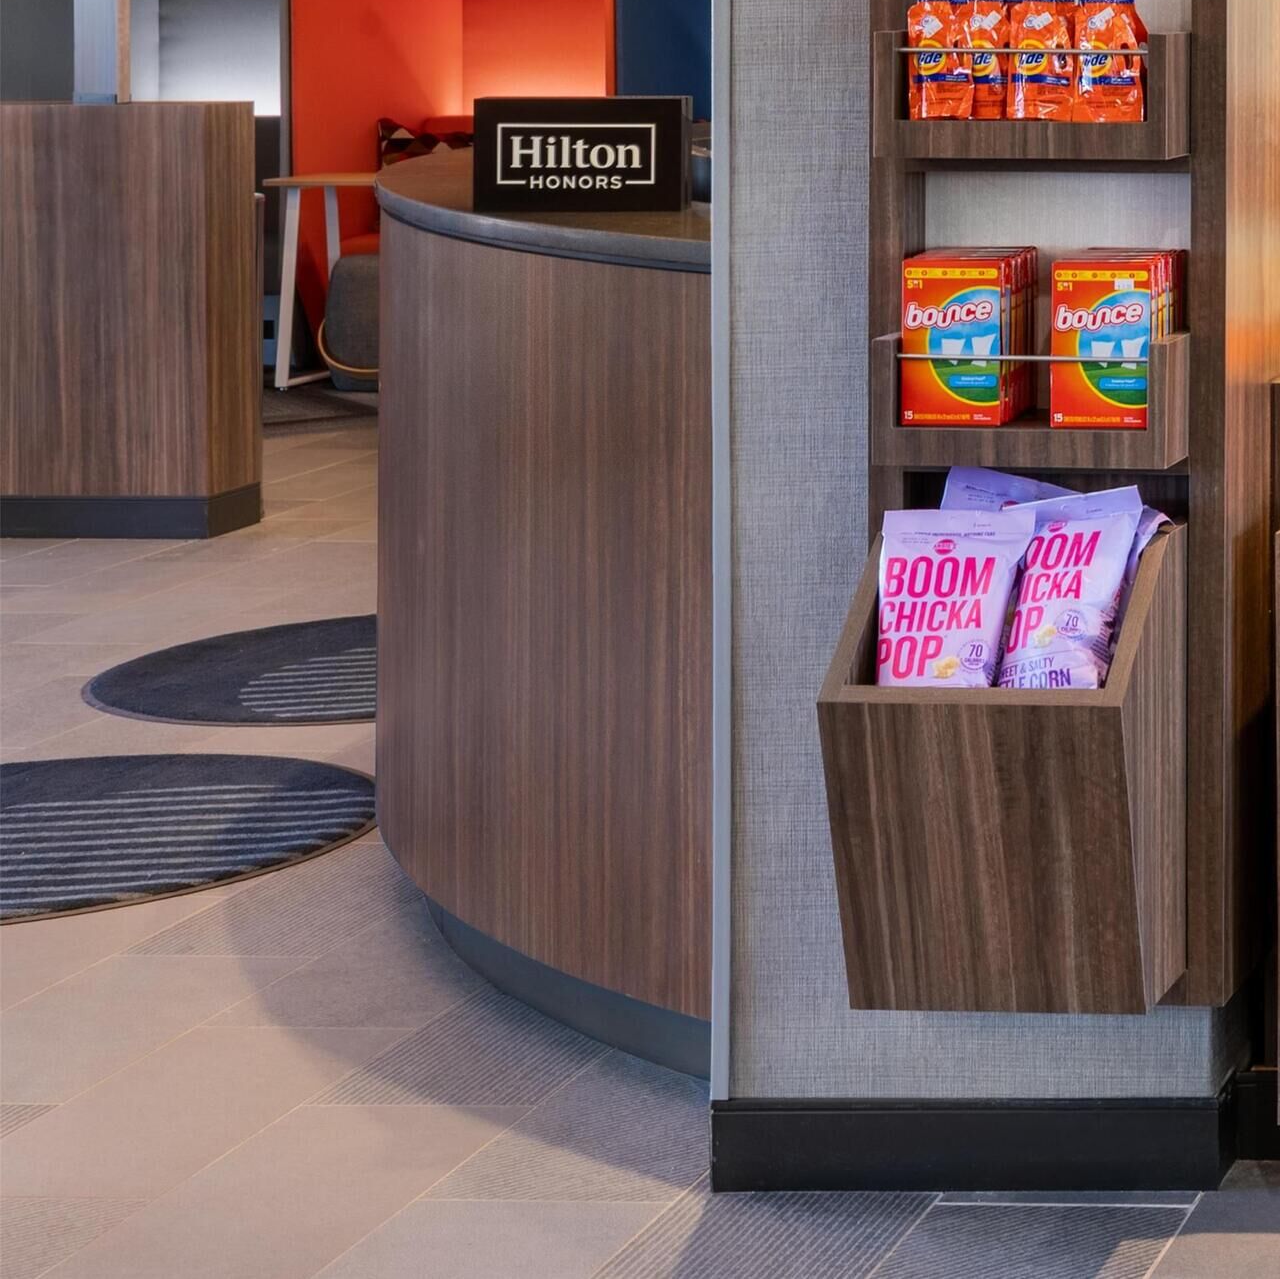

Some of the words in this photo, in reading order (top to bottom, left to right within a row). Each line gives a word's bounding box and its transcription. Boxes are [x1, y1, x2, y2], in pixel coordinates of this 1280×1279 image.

[510, 135, 643, 169] Hilton
[529, 175, 623, 190] HONORS
[905, 300, 993, 329] bounce
[1055, 303, 1144, 333] bounce
[1025, 530, 1102, 570] OOM
[884, 556, 996, 599] BOOM
[880, 598, 983, 635] CHICKA
[1005, 605, 1045, 655] OP
[1064, 614, 1079, 627] 70
[878, 635, 944, 680] POP
[969, 644, 983, 658] 70
[1028, 656, 1055, 672] SALTY
